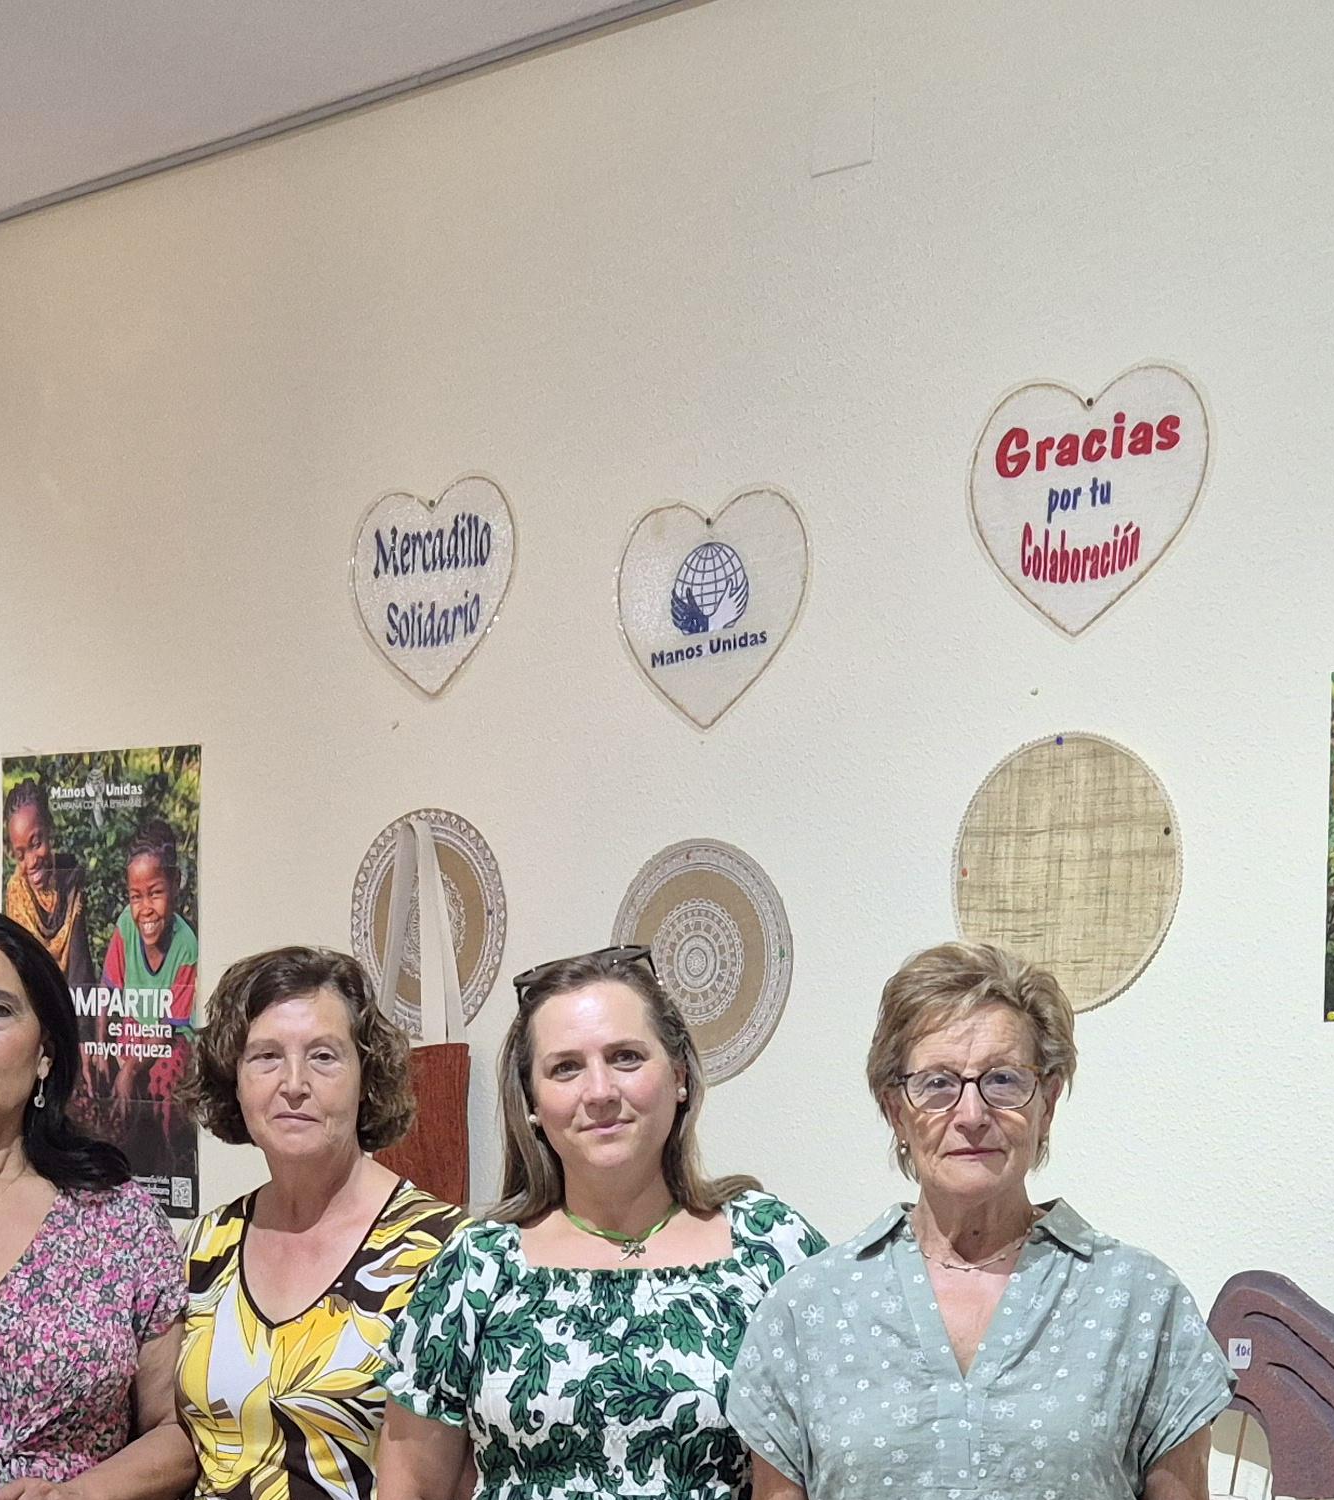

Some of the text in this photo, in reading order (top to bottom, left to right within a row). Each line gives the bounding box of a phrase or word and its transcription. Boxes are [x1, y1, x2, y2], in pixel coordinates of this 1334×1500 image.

[995, 411, 1181, 478] Gracias
[1047, 477, 1111, 524] por tu
[373, 512, 491, 579] Mercadillo
[1021, 521, 1141, 584] Colaboración
[385, 590, 481, 649] Solidario
[651, 629, 768, 669] Manos Unidas
[50, 782, 143, 798] Manos Unidas
[84, 1038, 172, 1062] mayor riqueza
[108, 1021, 172, 1038] es nuestra
